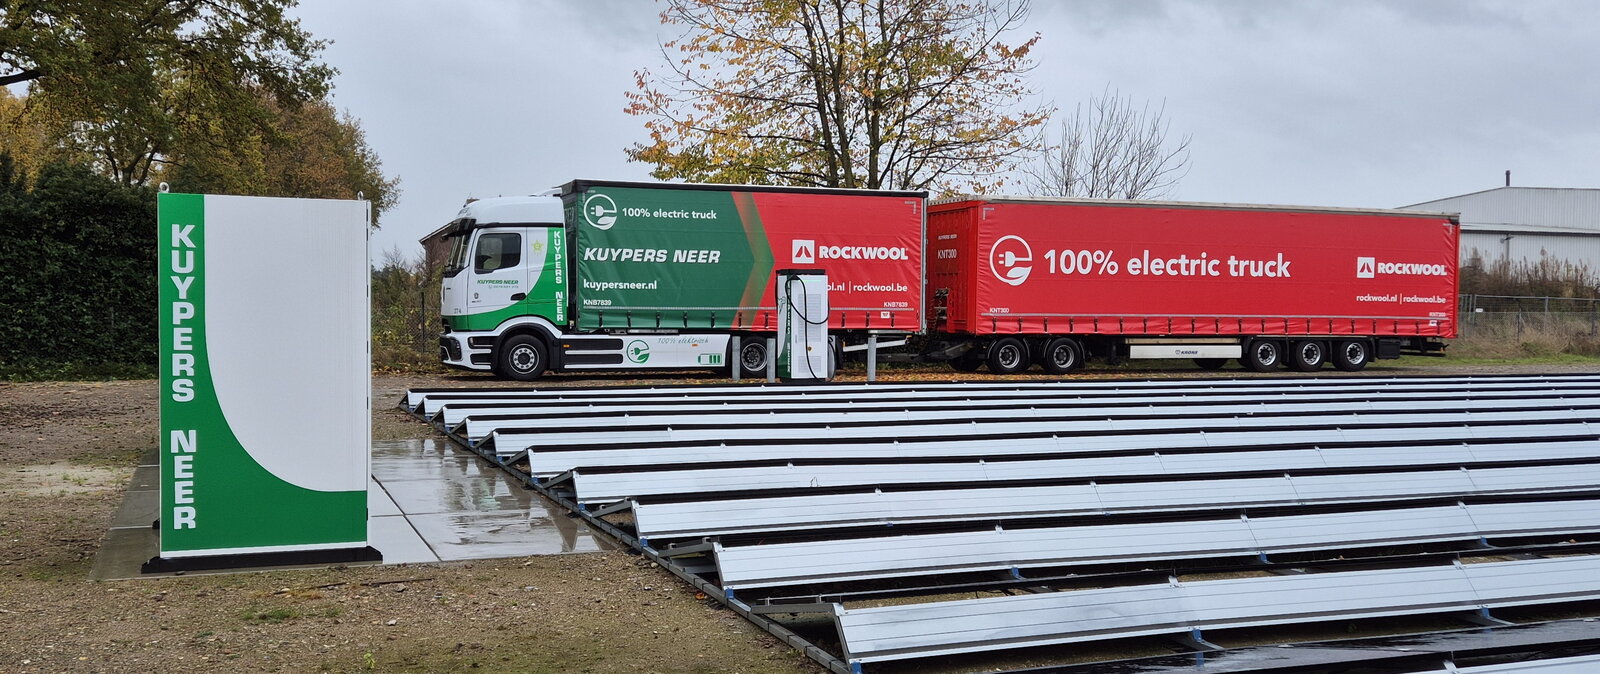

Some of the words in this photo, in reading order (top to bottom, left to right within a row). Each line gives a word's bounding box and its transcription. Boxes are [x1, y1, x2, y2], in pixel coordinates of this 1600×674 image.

[622, 207, 651, 218] 100%
[653, 208, 690, 219] electric
[692, 210, 717, 219] truck
[554, 230, 563, 284] KUYPERS
[583, 247, 668, 262] KUYPERS
[673, 249, 721, 263] NEER
[818, 246, 909, 260] ROCKWOOL
[937, 249, 957, 259] KNT300
[1044, 249, 1119, 275] 100%
[1127, 250, 1220, 276] electric
[1228, 252, 1291, 277] truck
[1377, 262, 1448, 276] ROCKWOOL
[583, 279, 657, 291] kuypersneer.nl
[853, 282, 908, 292] rockwool.be
[1356, 293, 1398, 303] rockwool.nl
[1403, 295, 1446, 304] rockwool.be
[170, 223, 197, 402] KUYPERS
[555, 291, 564, 322] NEER
[170, 429, 197, 530] NEER
